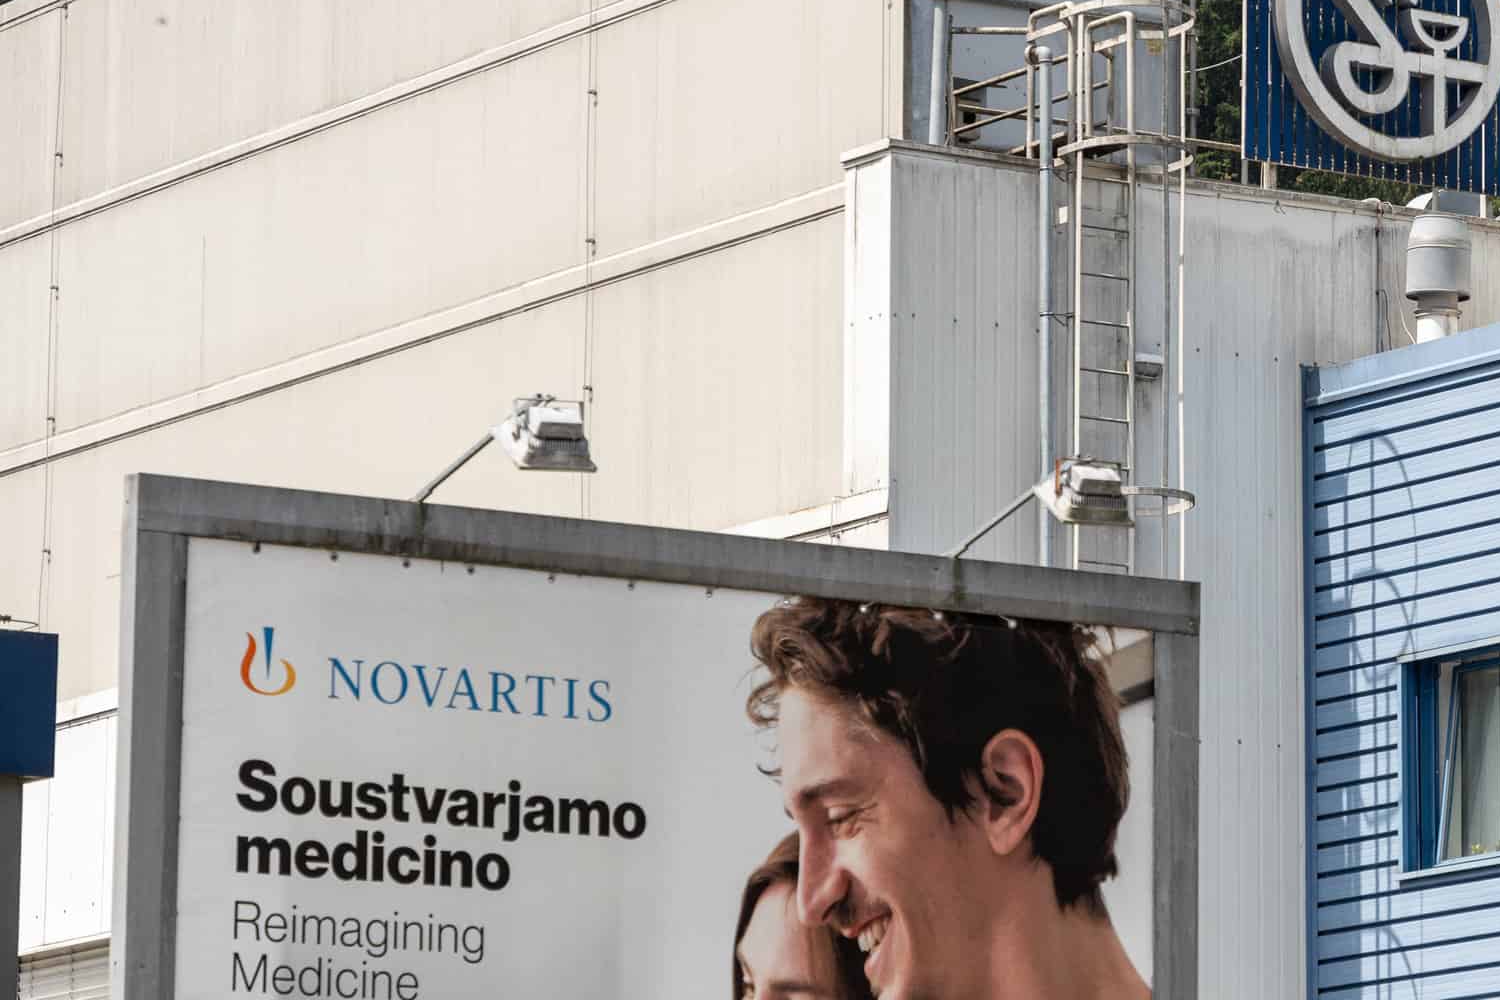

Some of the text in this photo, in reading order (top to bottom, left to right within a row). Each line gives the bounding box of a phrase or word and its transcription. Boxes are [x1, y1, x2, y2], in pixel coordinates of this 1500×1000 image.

[327, 657, 613, 723] NOVARTIS
[235, 758, 648, 843] Soustvarjamo
[235, 828, 512, 892] medicino
[233, 899, 486, 965] Reimagining
[231, 951, 420, 1000] Medicine
